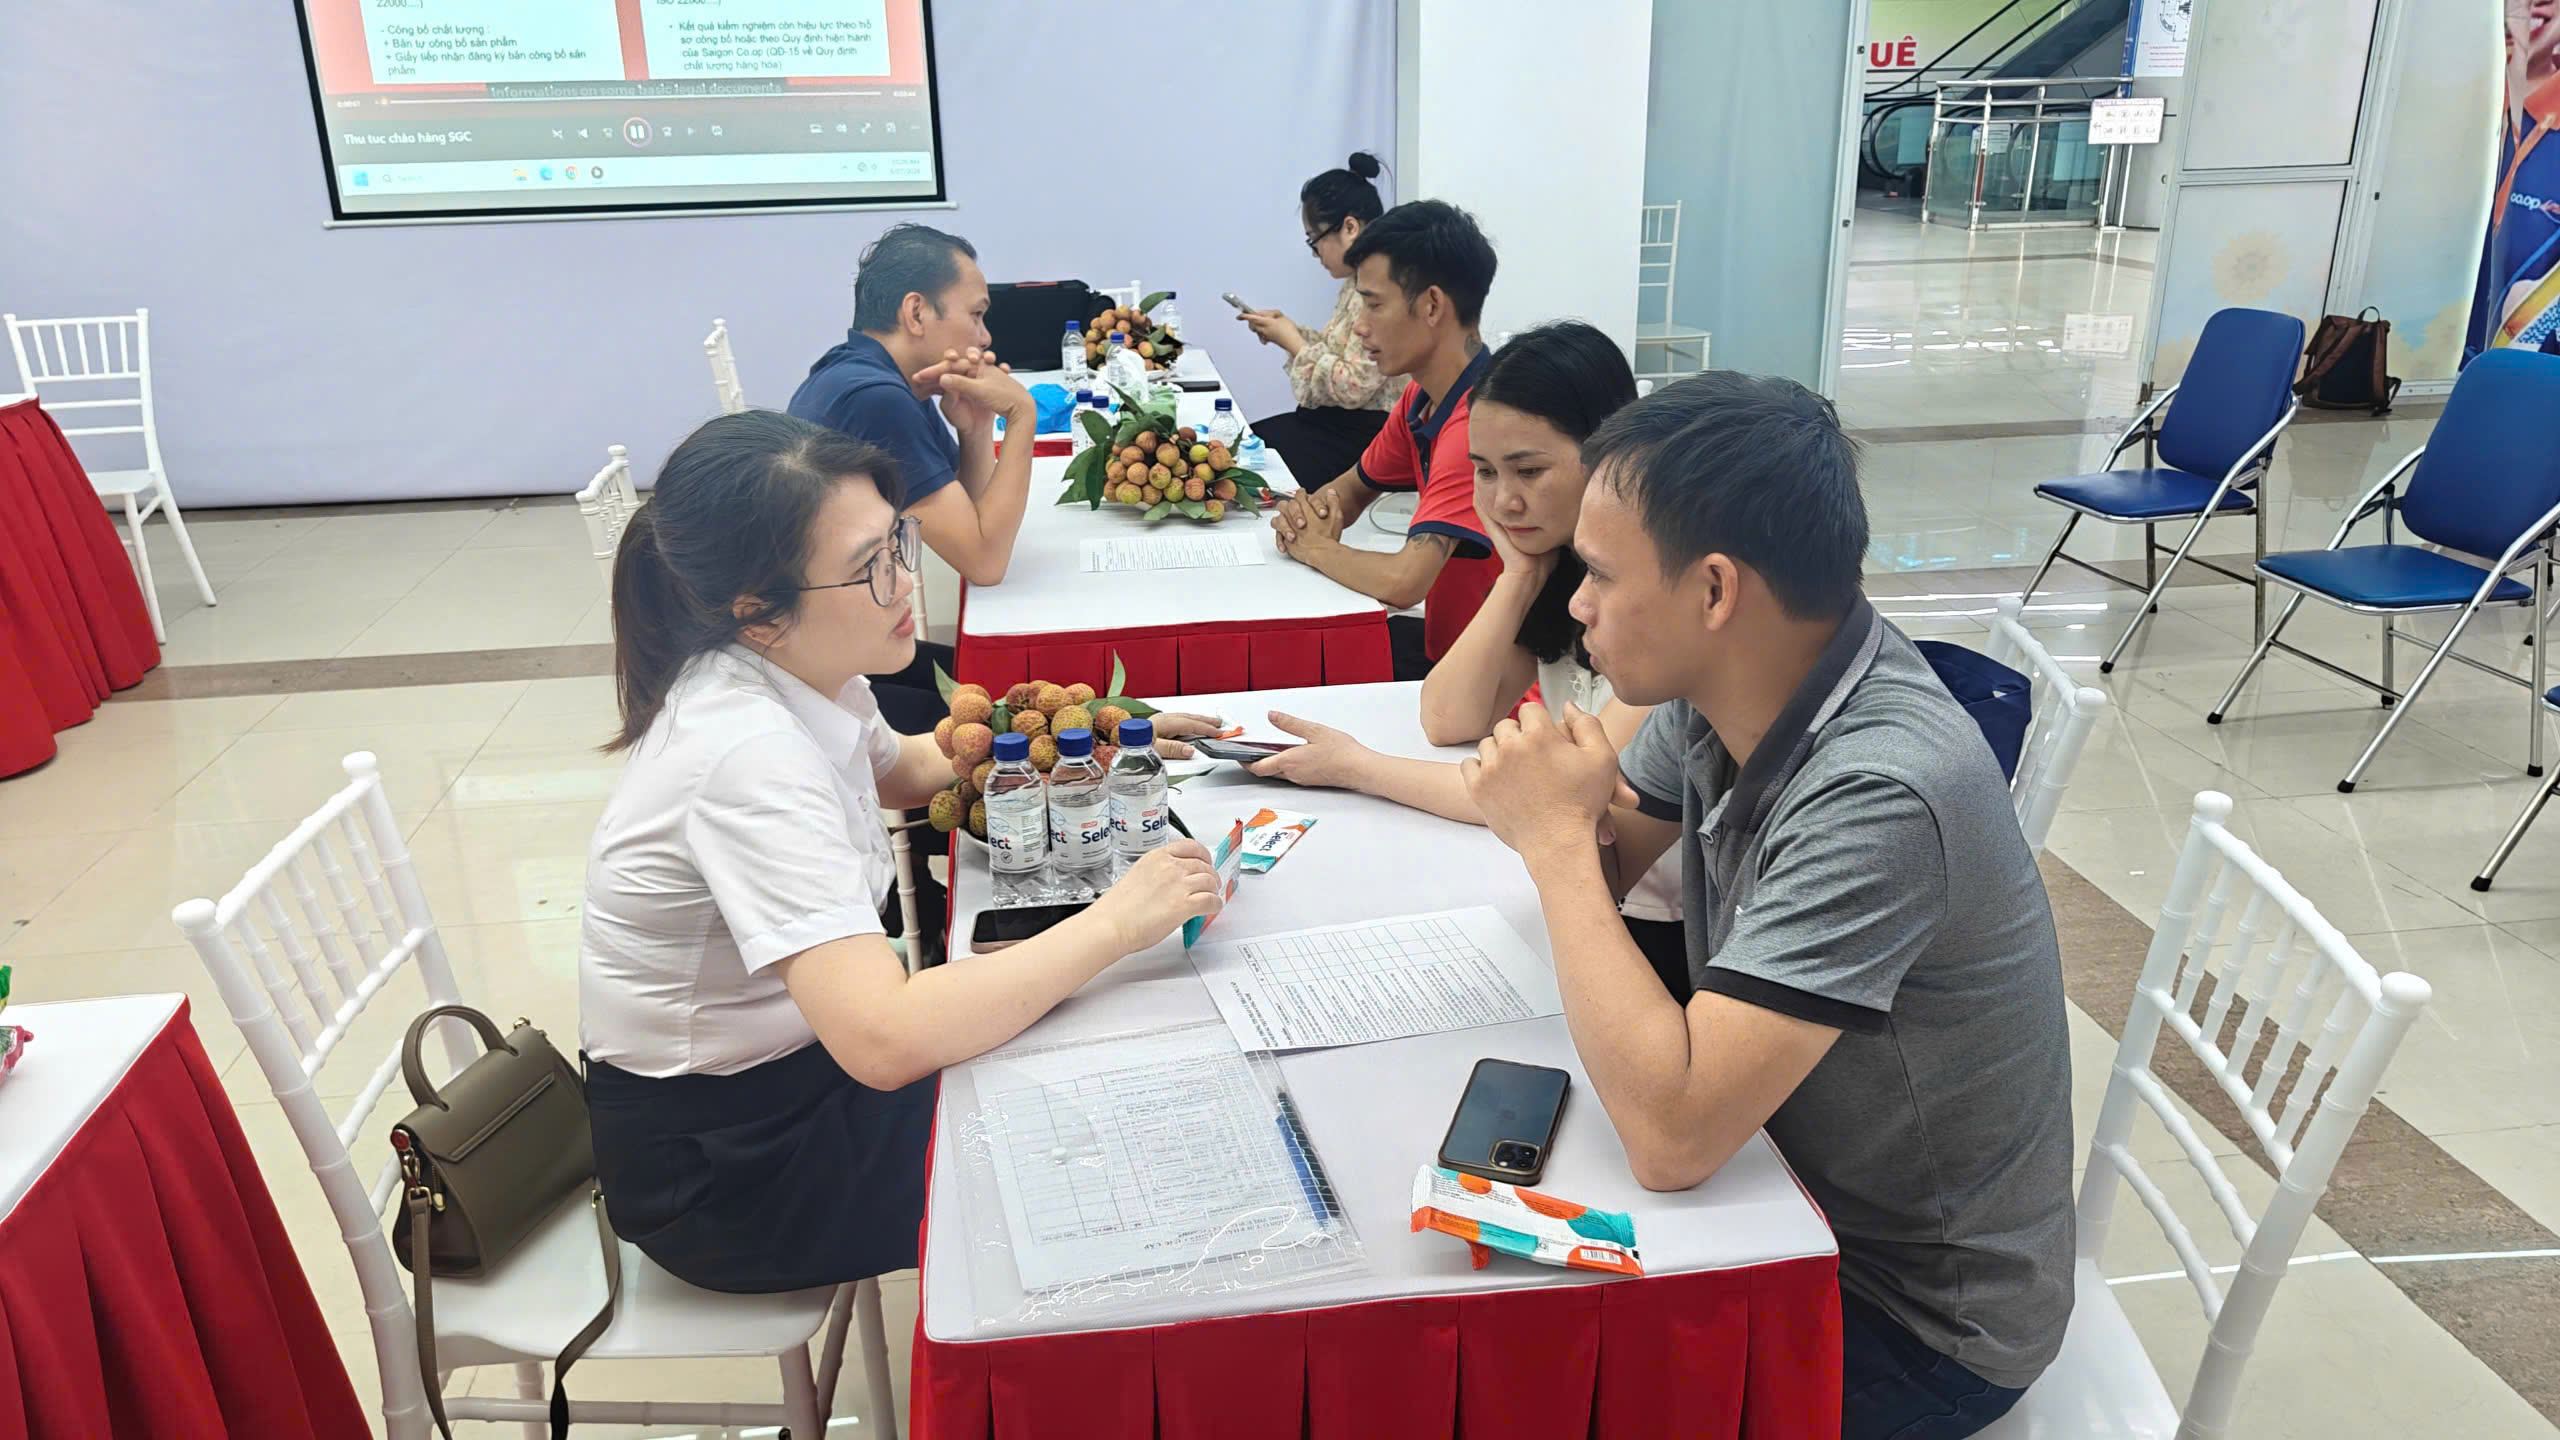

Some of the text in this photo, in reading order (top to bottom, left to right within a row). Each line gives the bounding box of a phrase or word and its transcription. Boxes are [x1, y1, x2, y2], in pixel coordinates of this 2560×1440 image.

[387, 24, 414, 36] Công
[702, 47, 733, 58] Saigon
[447, 131, 473, 143] SGC
[1258, 831, 1288, 851] Select
